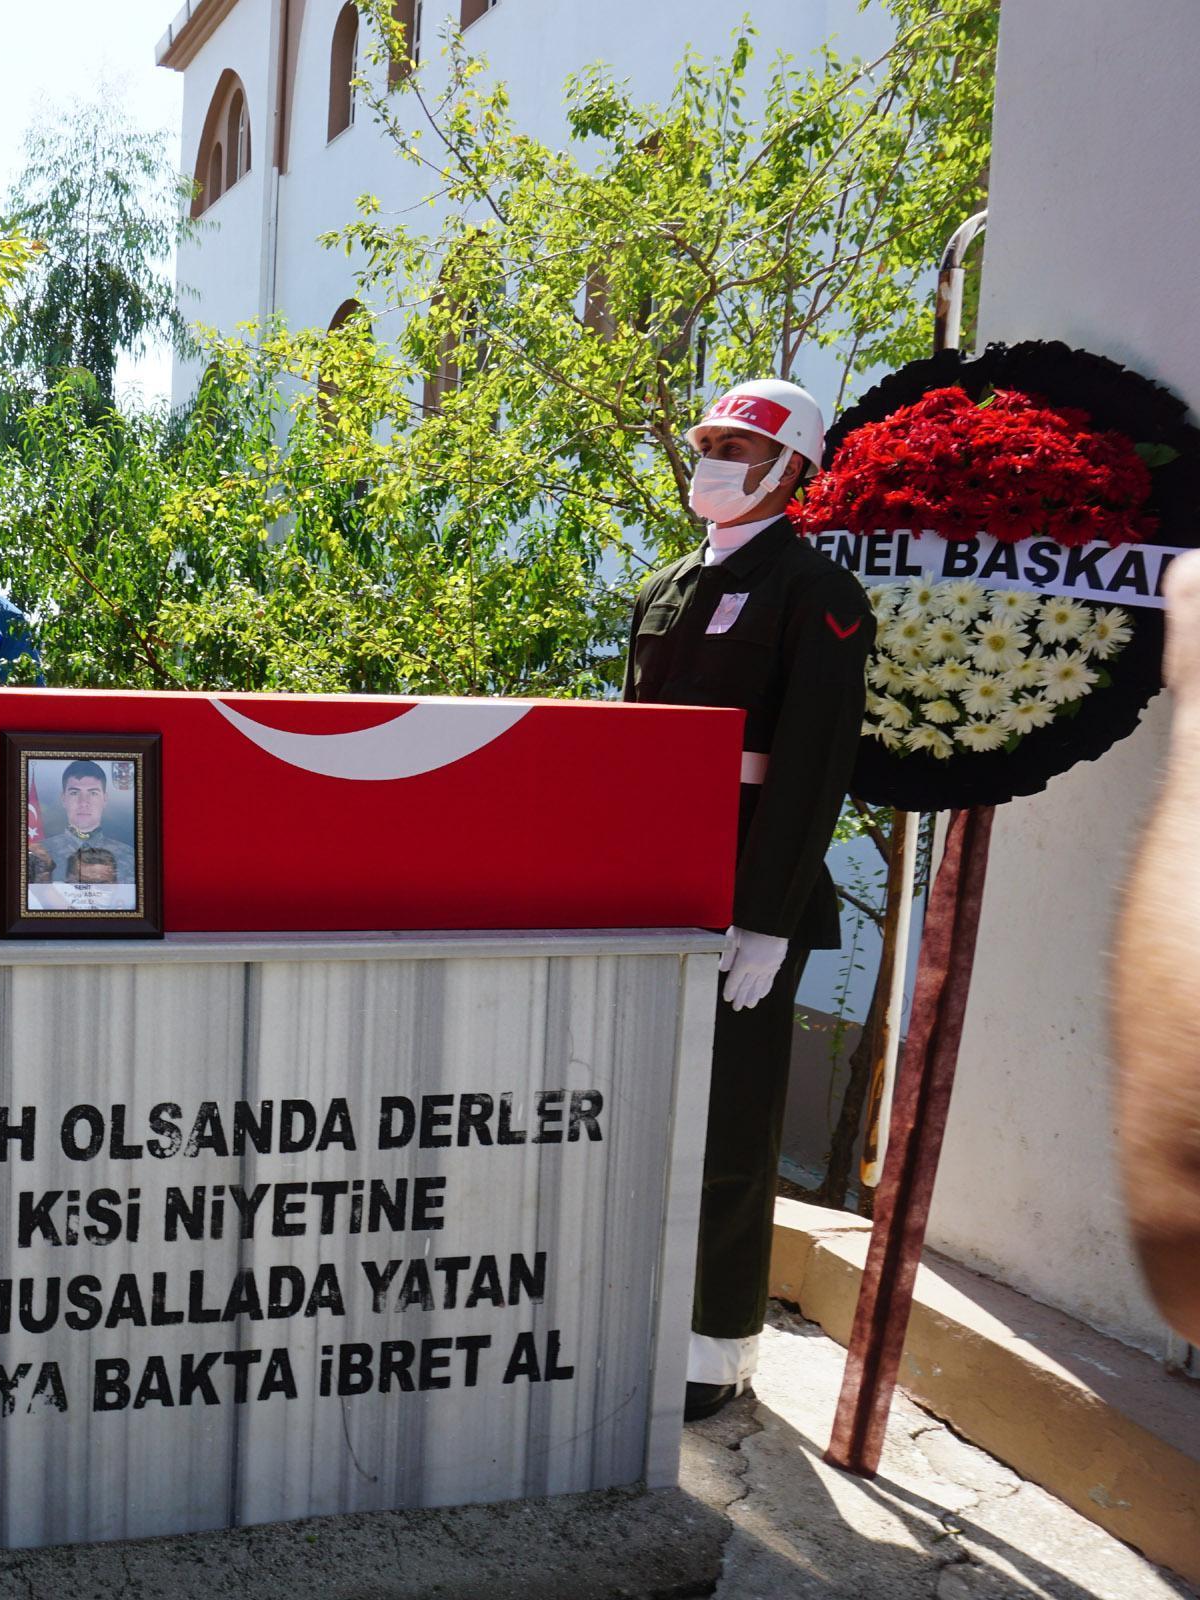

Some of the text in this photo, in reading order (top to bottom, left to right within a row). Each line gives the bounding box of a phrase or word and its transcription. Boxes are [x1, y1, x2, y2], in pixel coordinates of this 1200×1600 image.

[808, 532, 923, 577] ENEL
[60, 1097, 357, 1161] OLSANDA
[378, 1088, 604, 1150] DERLER
[361, 1251, 547, 1314] YATAN
[93, 1347, 298, 1412] BAKTA
[502, 1329, 575, 1384] AL
